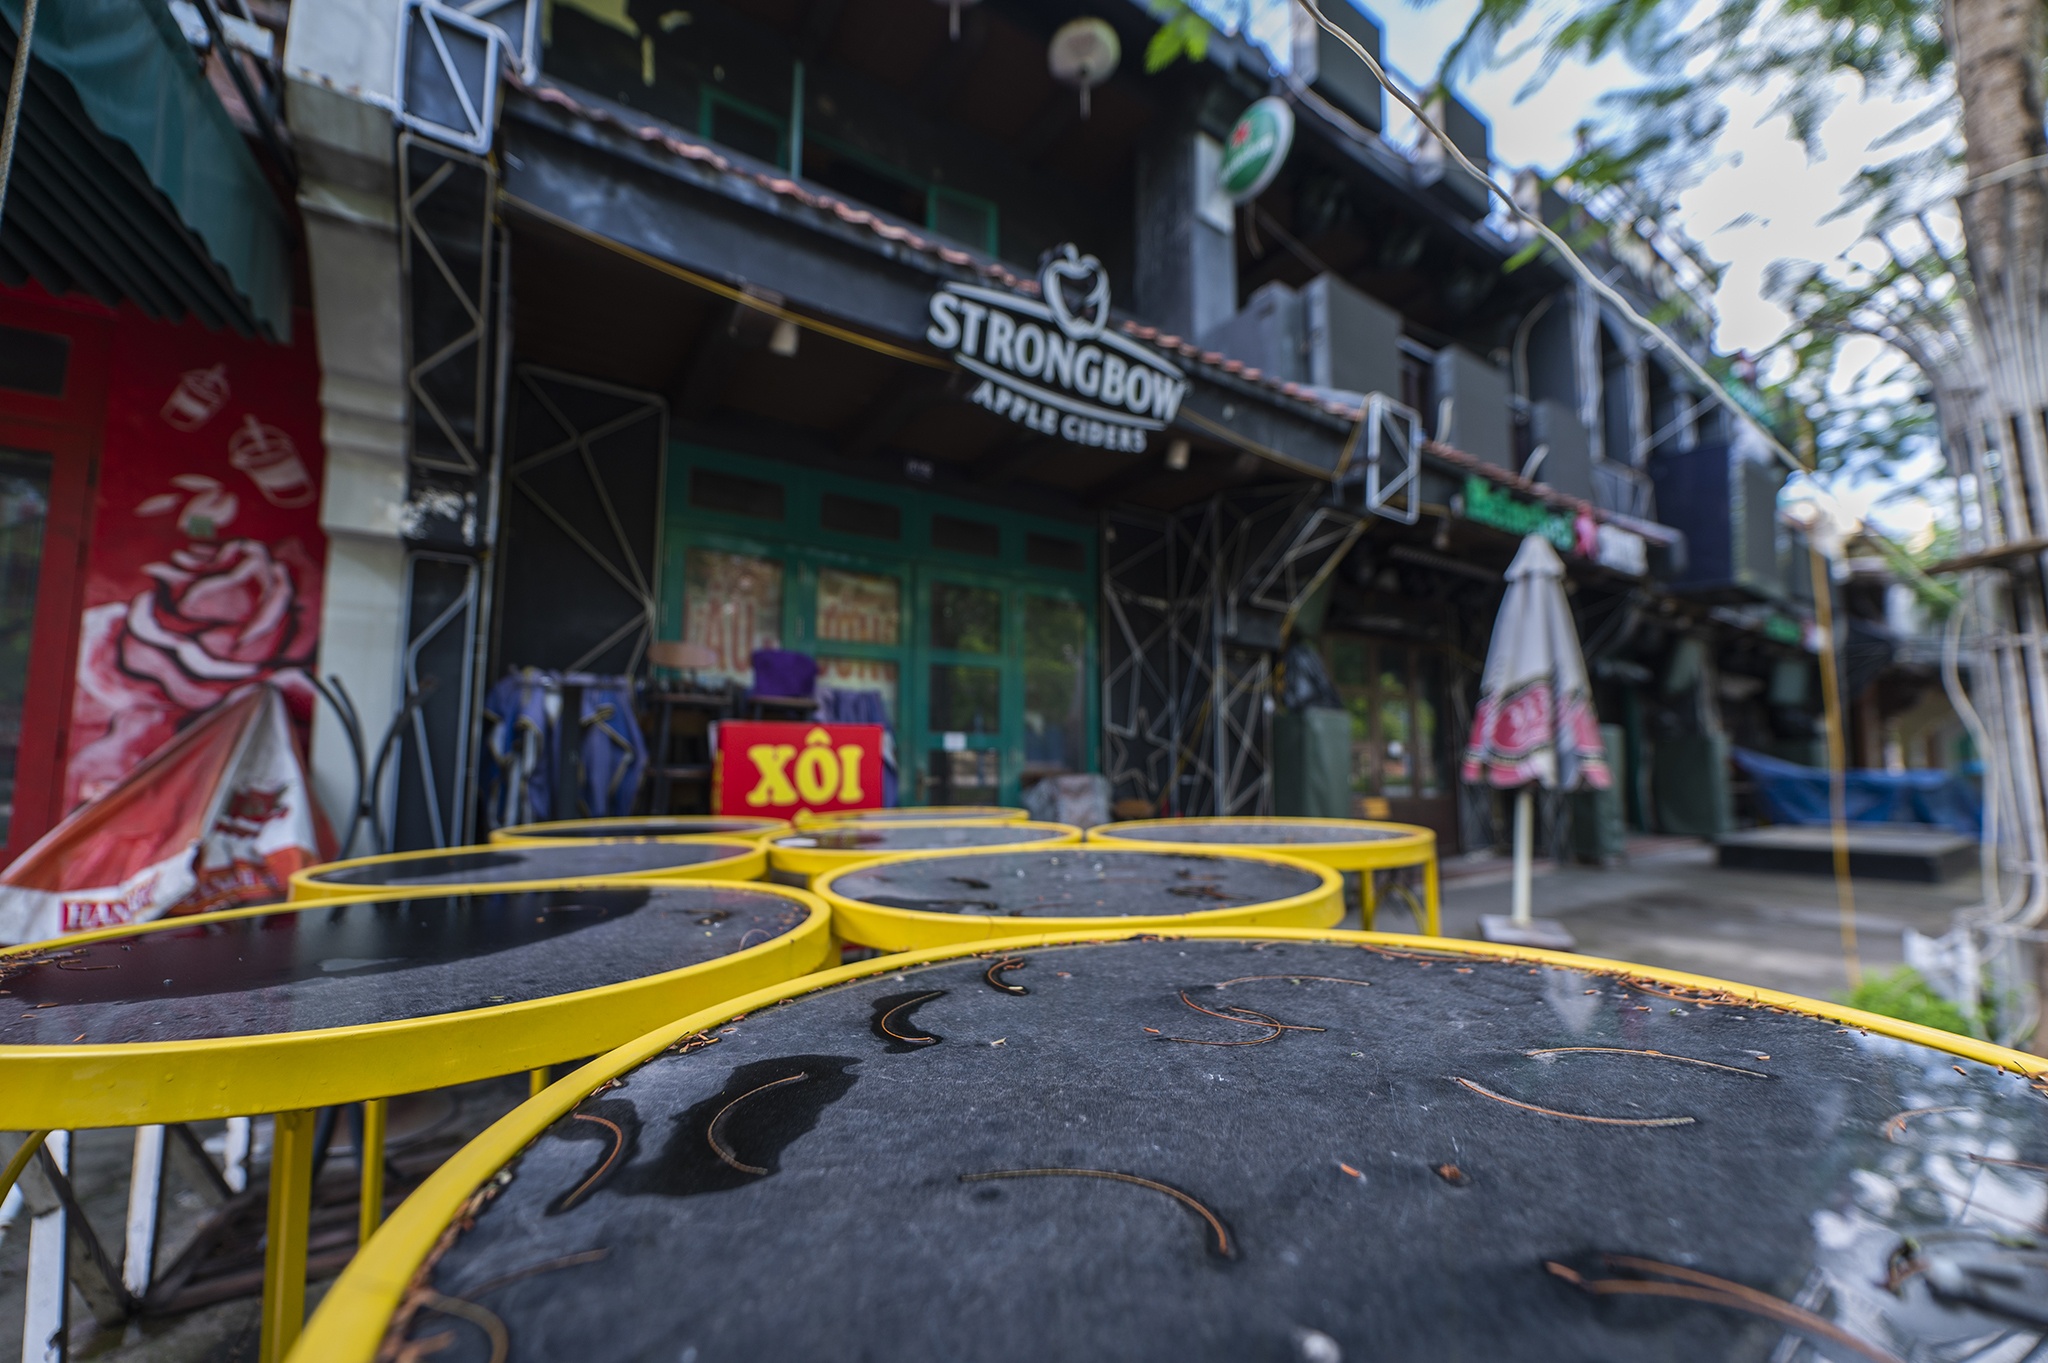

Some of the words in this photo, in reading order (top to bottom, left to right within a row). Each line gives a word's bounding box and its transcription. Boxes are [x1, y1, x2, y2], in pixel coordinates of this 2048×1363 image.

[926, 291, 1185, 424] STRONGBOW
[971, 380, 1060, 436] APPLE
[1061, 413, 1148, 453] CIDERS
[746, 727, 864, 807] XÔI
